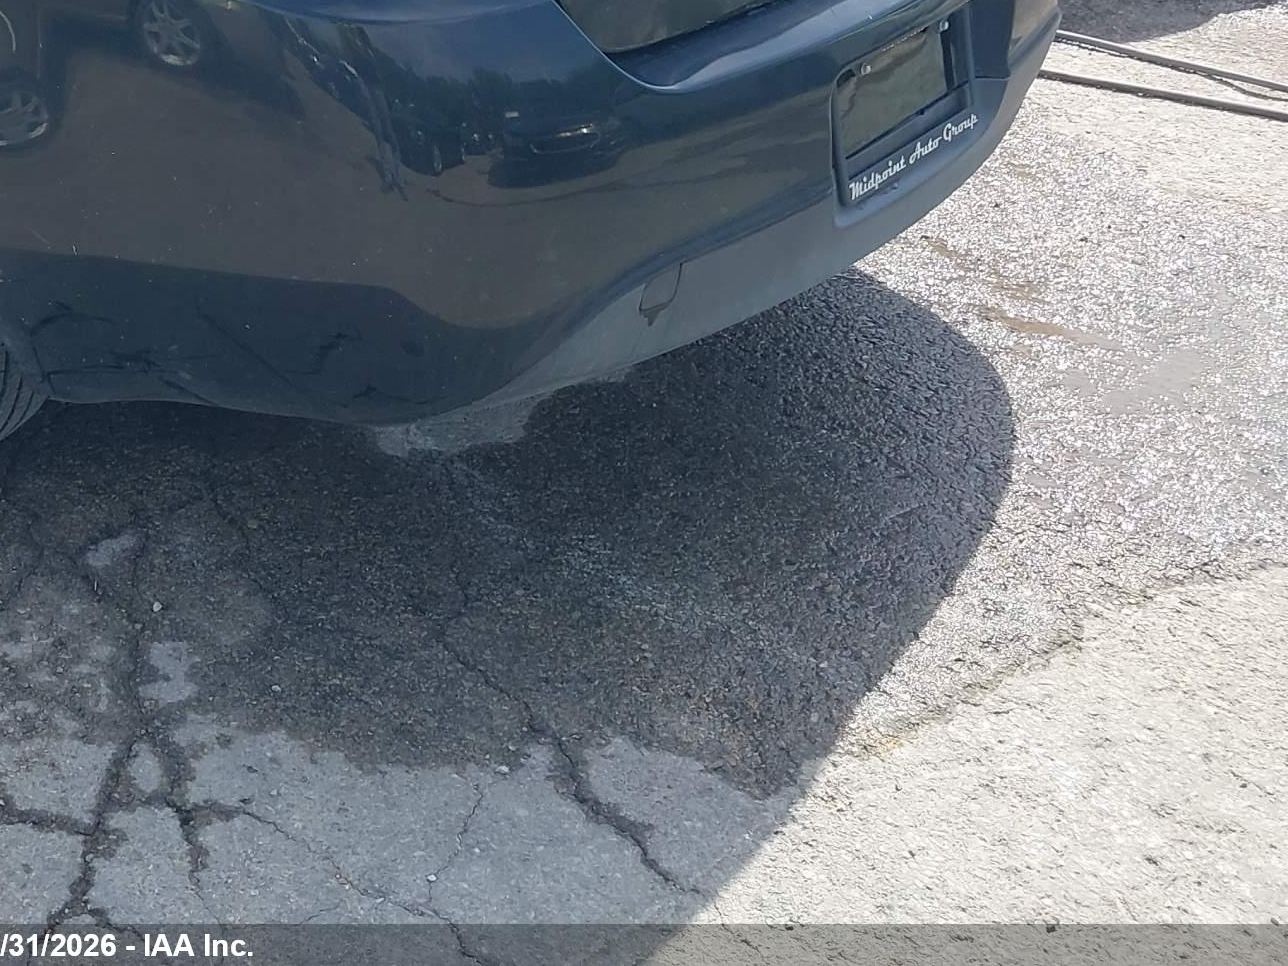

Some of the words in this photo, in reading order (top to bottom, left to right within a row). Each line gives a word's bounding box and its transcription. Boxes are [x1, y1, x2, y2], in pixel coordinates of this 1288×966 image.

[848, 158, 907, 201] Midpoint
[909, 136, 943, 166] Auto
[942, 113, 979, 142] Group
